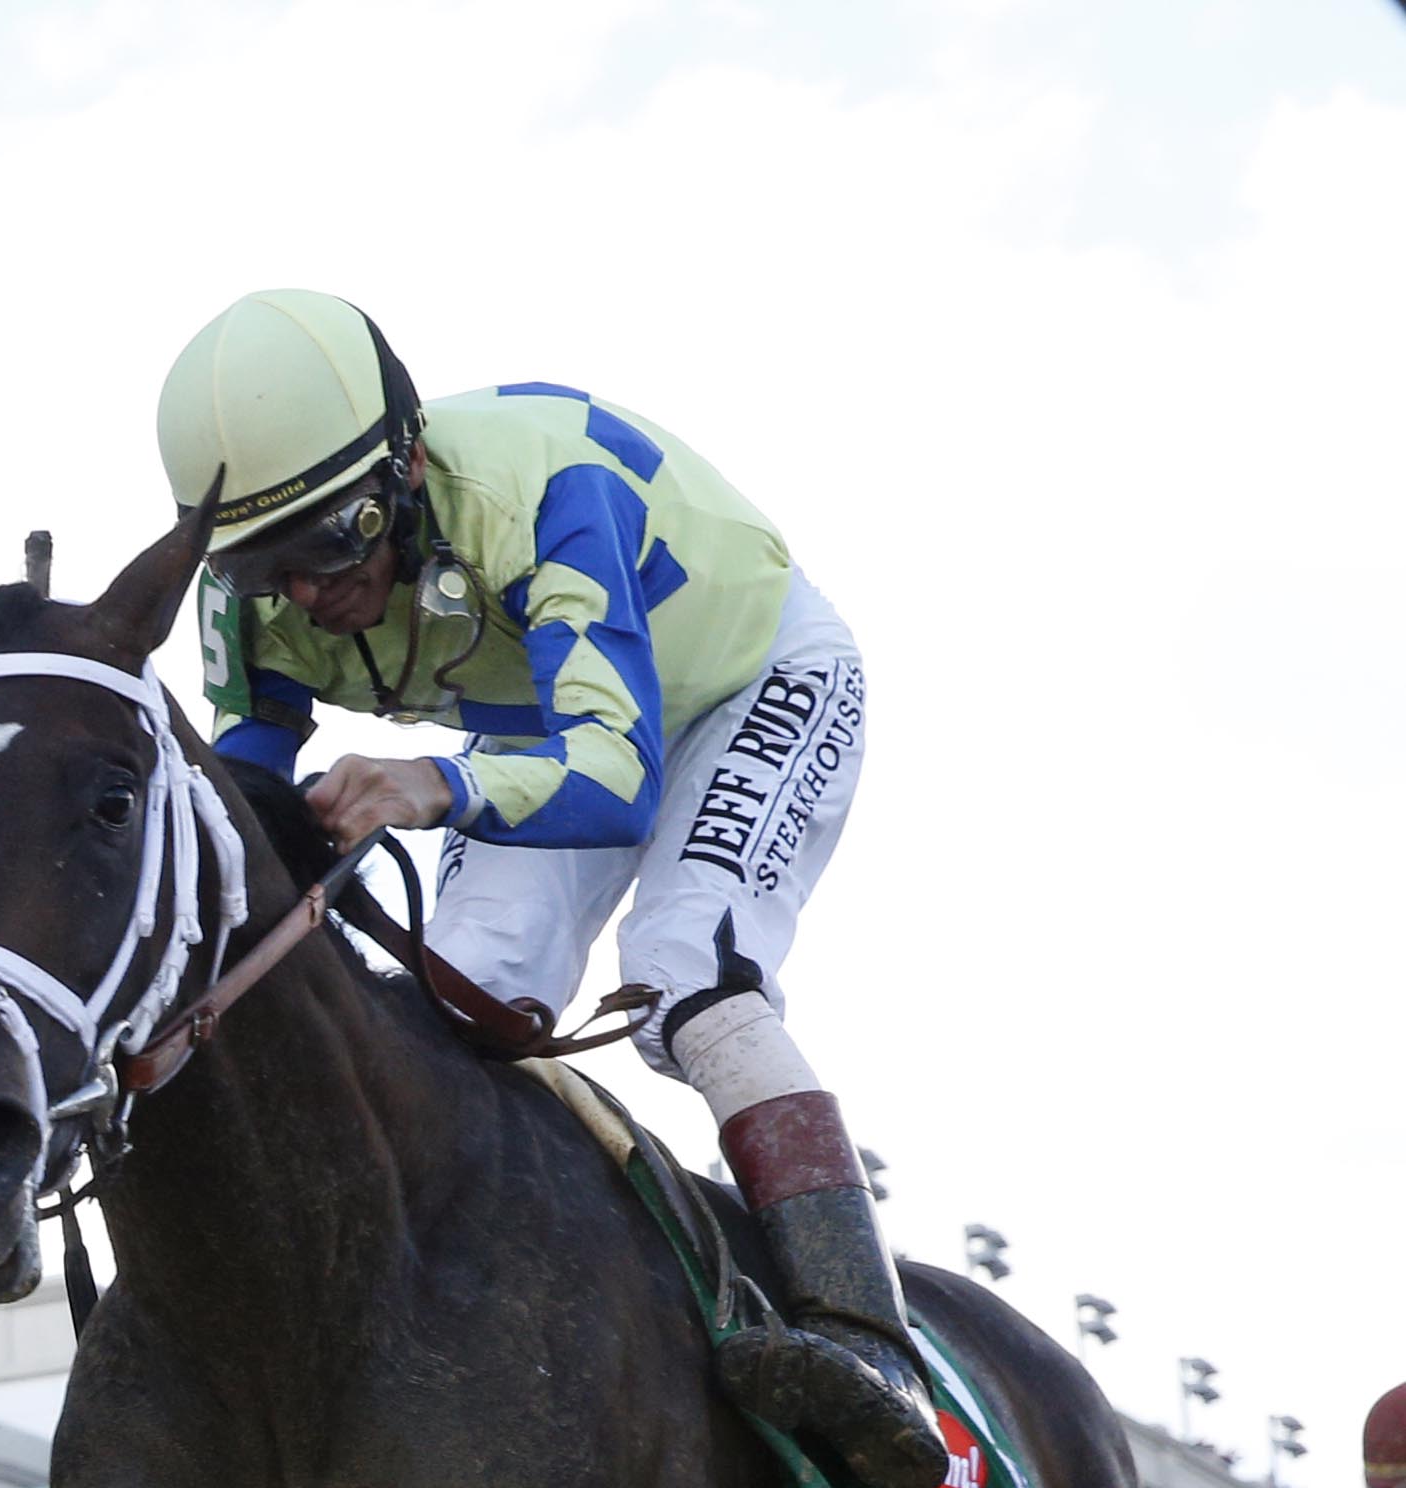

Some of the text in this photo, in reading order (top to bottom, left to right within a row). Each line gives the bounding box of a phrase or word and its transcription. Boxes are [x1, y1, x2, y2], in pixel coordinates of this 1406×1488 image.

[257, 480, 307, 507] Guild
[201, 584, 229, 688] 5
[679, 767, 767, 883] JEFF
[757, 664, 864, 892] STEAKHOUSES
